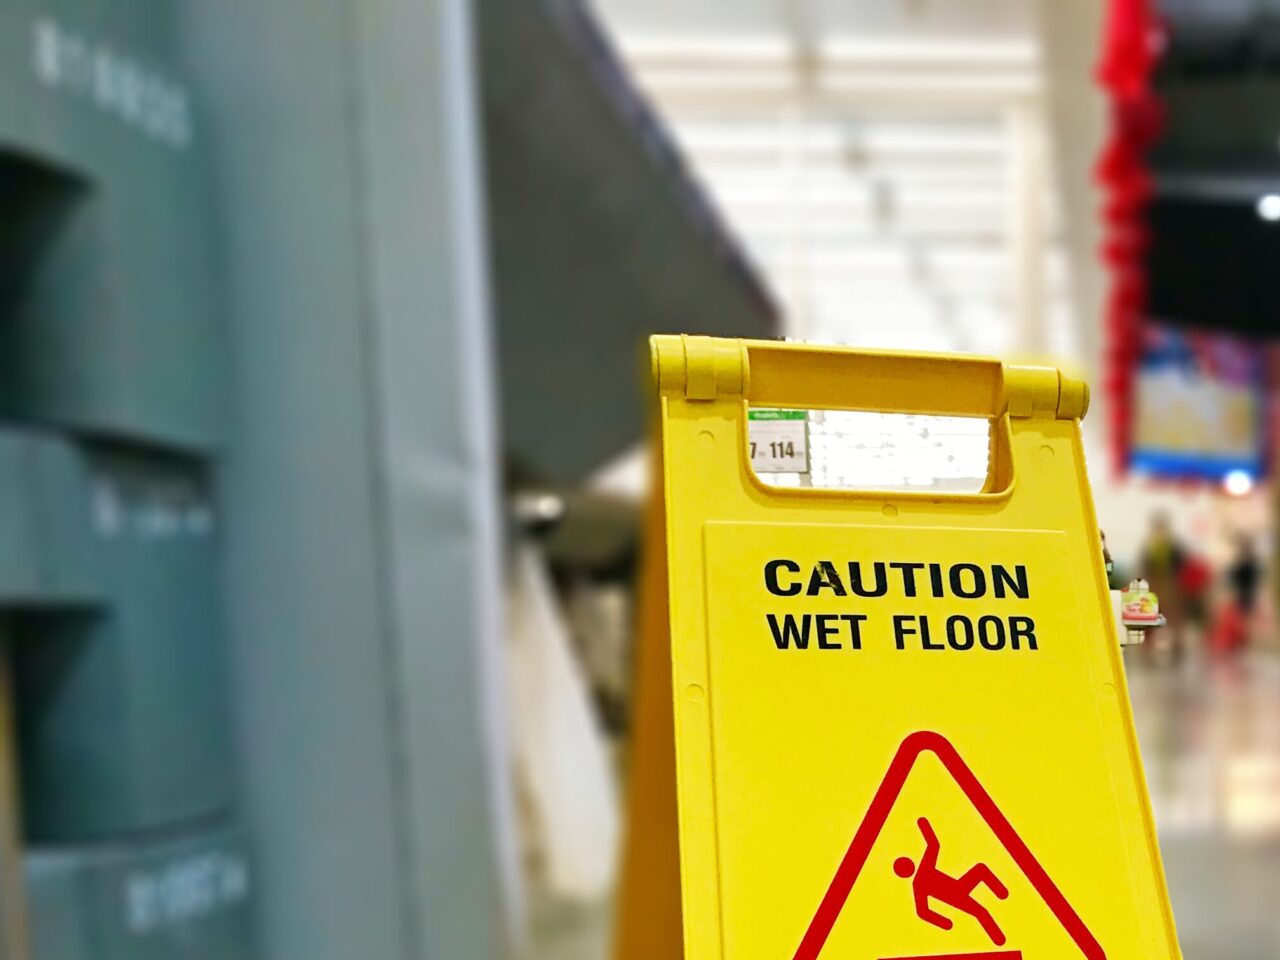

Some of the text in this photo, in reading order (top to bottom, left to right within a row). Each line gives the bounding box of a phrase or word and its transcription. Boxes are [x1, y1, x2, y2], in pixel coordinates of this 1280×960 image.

[769, 441, 795, 459] 114
[764, 559, 1030, 599] CAUTION
[766, 613, 1039, 651] WET FLOOR
